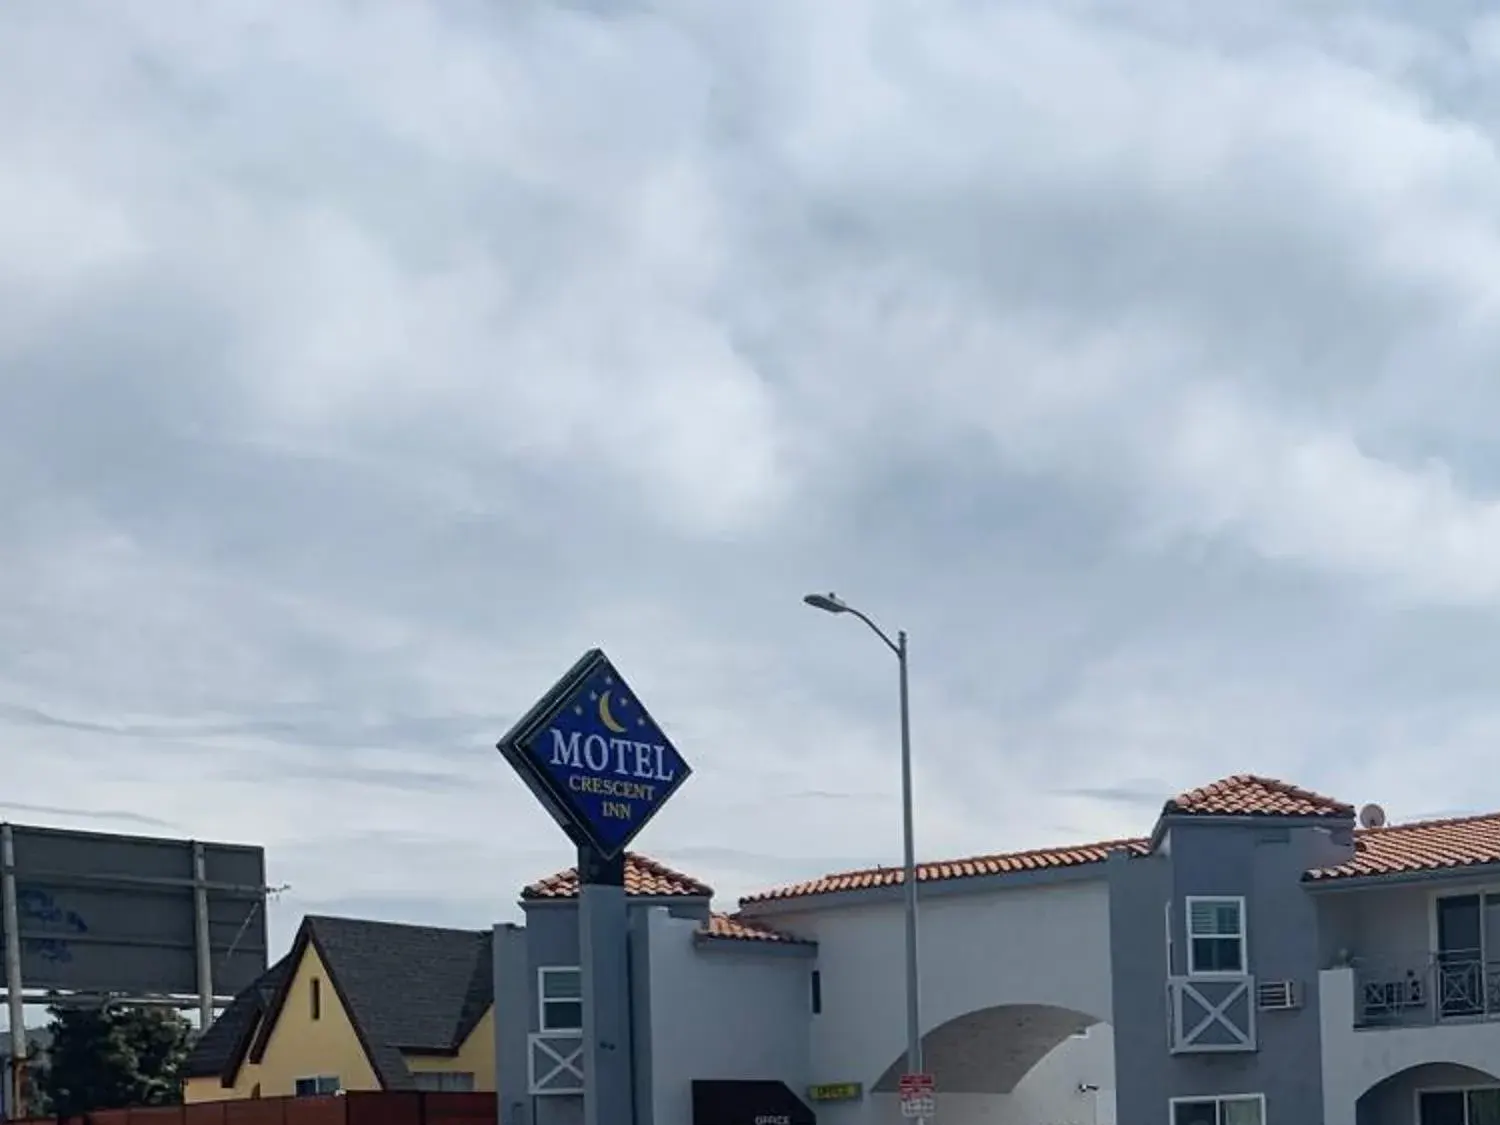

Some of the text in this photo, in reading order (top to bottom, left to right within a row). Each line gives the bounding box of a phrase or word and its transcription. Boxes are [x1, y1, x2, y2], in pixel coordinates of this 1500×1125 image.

[550, 728, 673, 781] MOTEL
[569, 775, 655, 801] CRESCENT
[602, 801, 631, 820] INN
